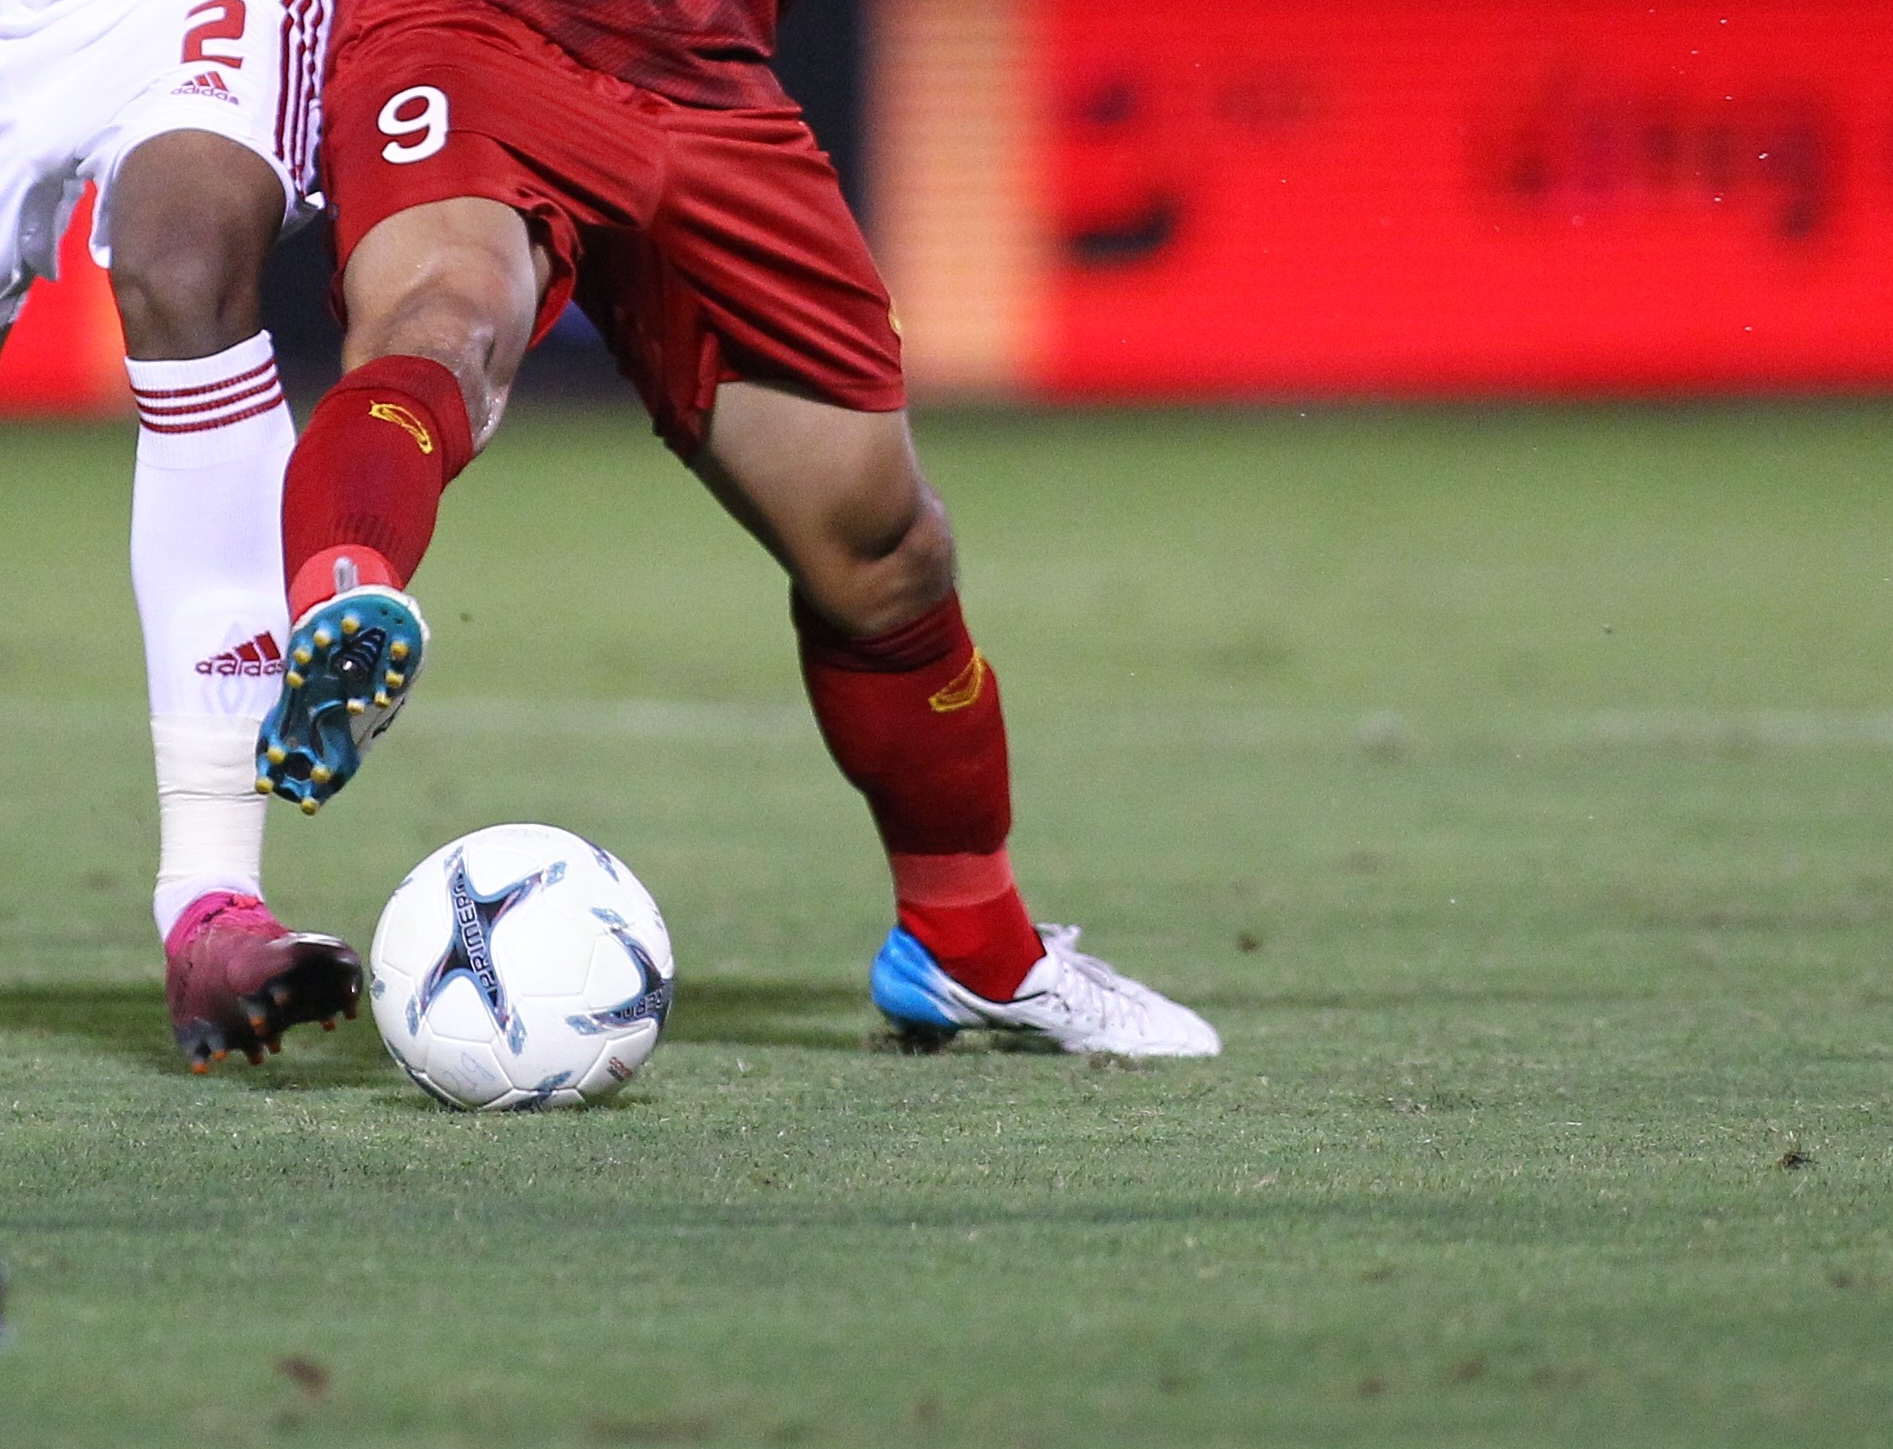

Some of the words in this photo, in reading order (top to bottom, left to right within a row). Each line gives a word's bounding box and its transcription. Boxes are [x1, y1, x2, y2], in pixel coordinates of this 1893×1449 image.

[170, 84, 239, 105] adidas
[377, 84, 450, 165] 9
[195, 657, 285, 677] adidas
